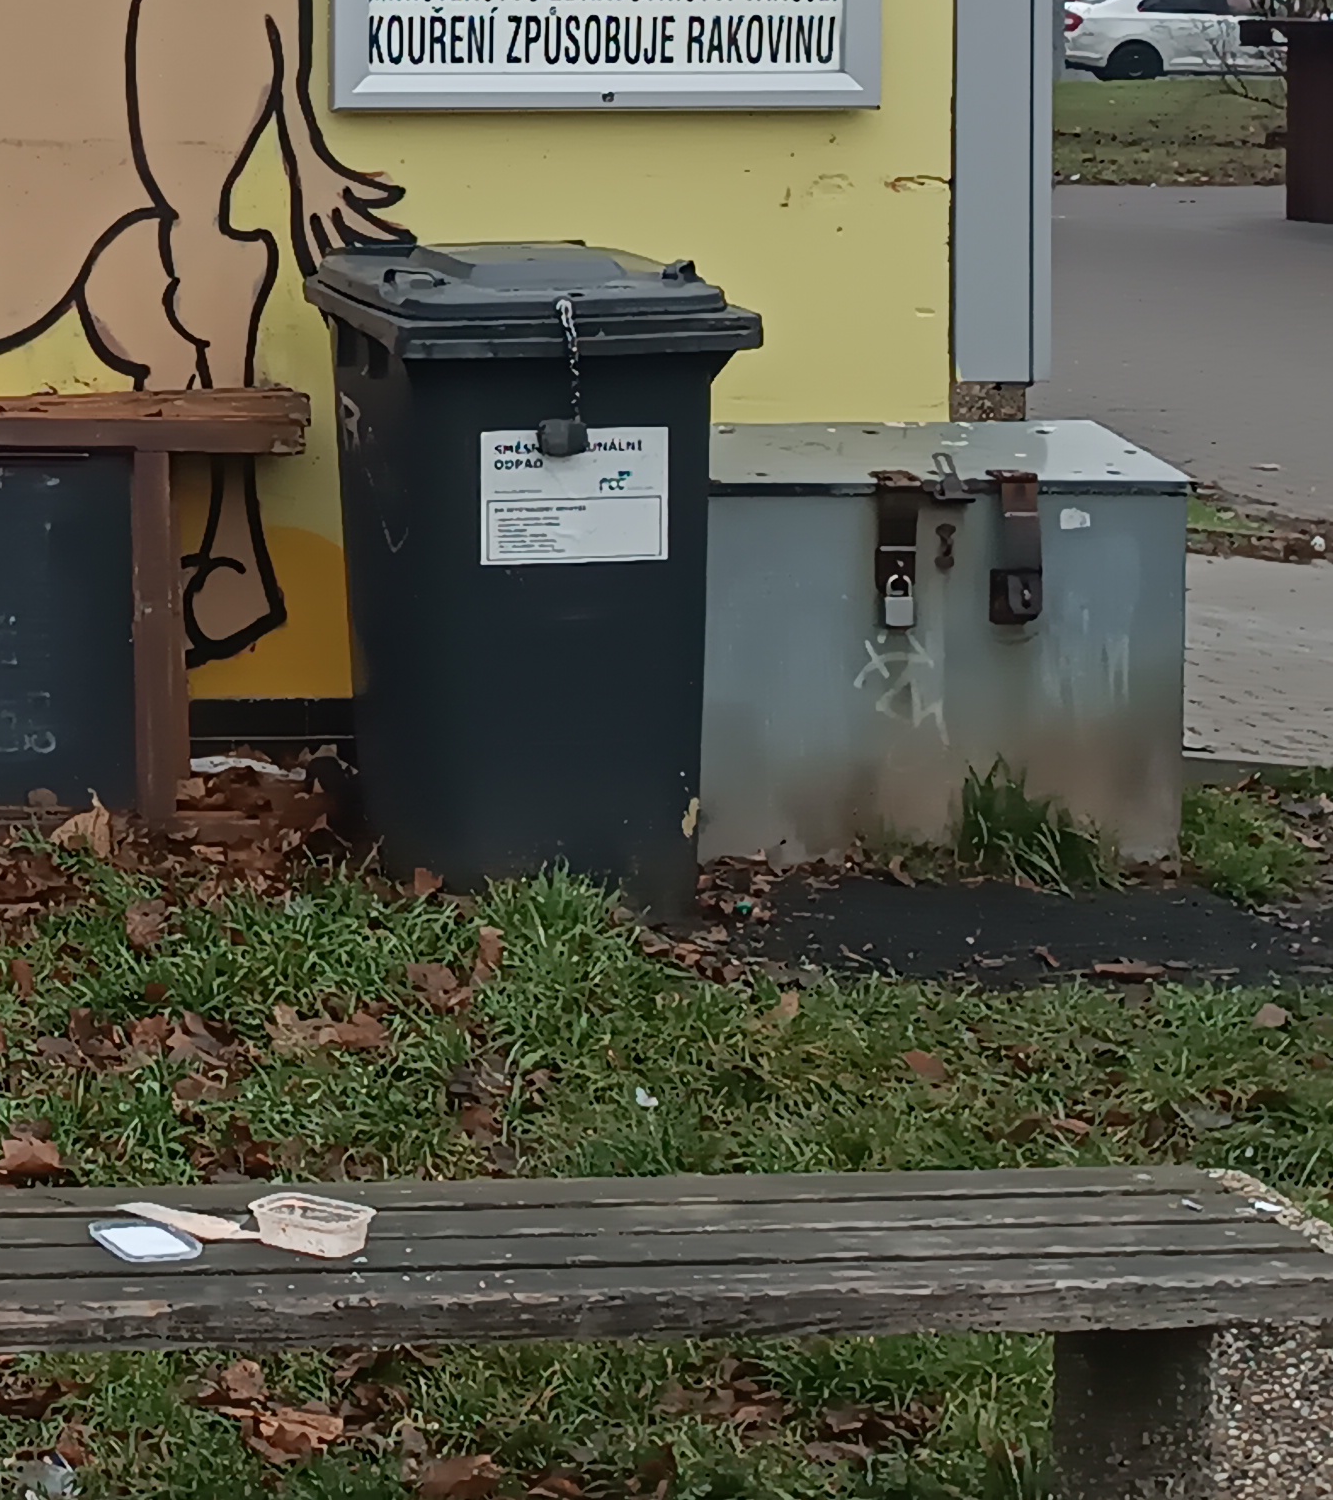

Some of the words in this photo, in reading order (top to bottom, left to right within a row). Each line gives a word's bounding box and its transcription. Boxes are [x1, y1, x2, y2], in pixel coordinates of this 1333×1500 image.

[368, 6, 498, 65] KOUŘENÍ
[507, 6, 674, 65] ZPŮSOBUJE
[686, 14, 835, 64] RAKOVINU
[494, 459, 543, 470] ODPAD
